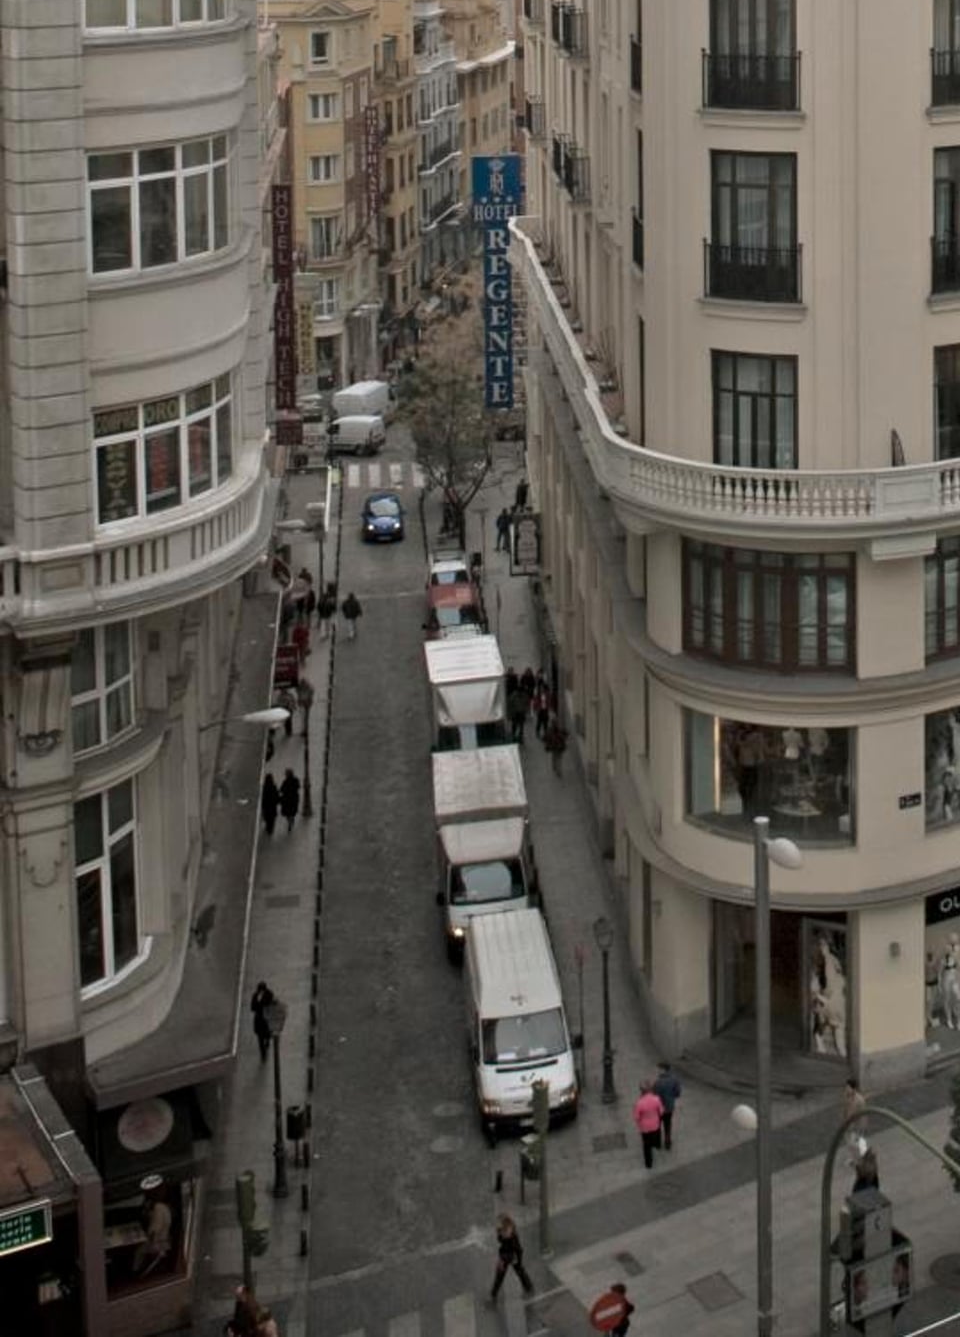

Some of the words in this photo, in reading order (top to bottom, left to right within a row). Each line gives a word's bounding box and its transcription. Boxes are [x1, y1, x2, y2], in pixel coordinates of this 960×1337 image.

[275, 191, 289, 264] HOTEL
[474, 204, 517, 222] HOTEL
[486, 229, 510, 404] REGENTE
